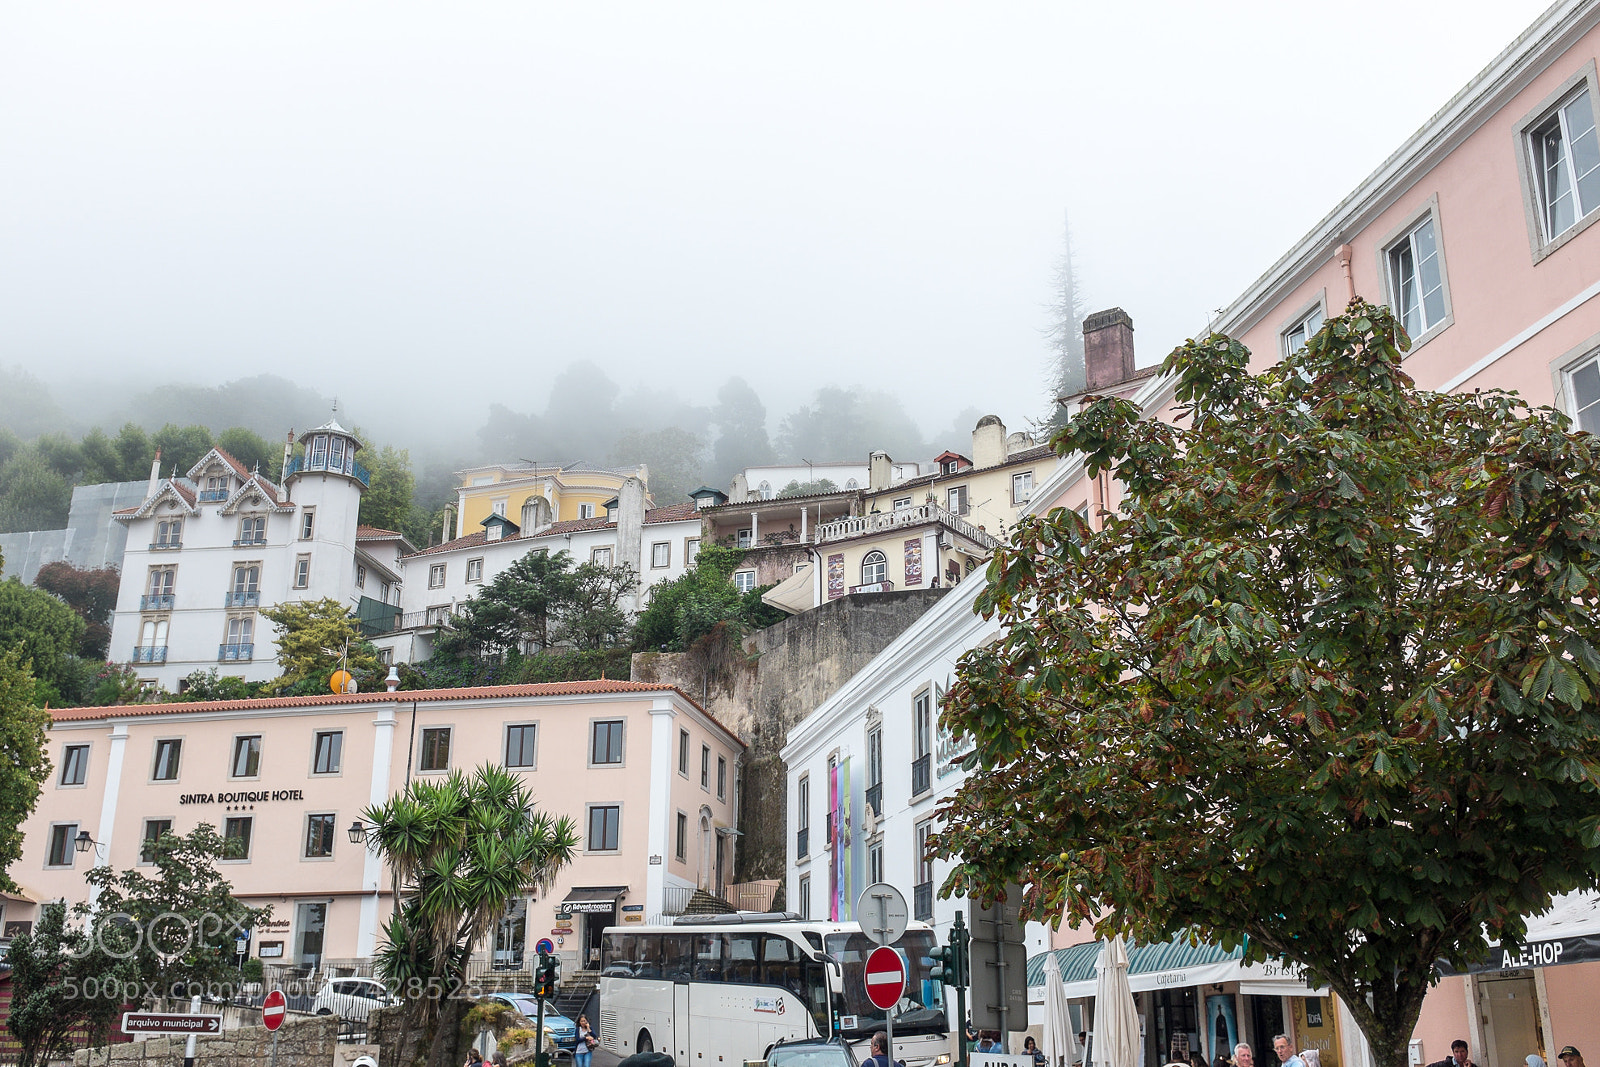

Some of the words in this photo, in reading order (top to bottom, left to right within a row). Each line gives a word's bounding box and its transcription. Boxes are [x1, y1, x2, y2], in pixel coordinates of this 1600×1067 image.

[179, 794, 215, 805] SINTRA
[217, 791, 270, 804] BOUTIQUE
[272, 790, 304, 801] HOTEL
[1501, 942, 1563, 968] ALE-HOP
[1156, 973, 1187, 987] Cafetaria
[127, 1018, 160, 1028] arquivo
[162, 1019, 204, 1029] municipal
[1307, 1013, 1322, 1024] TOFA
[1302, 1035, 1330, 1050] Bristol
